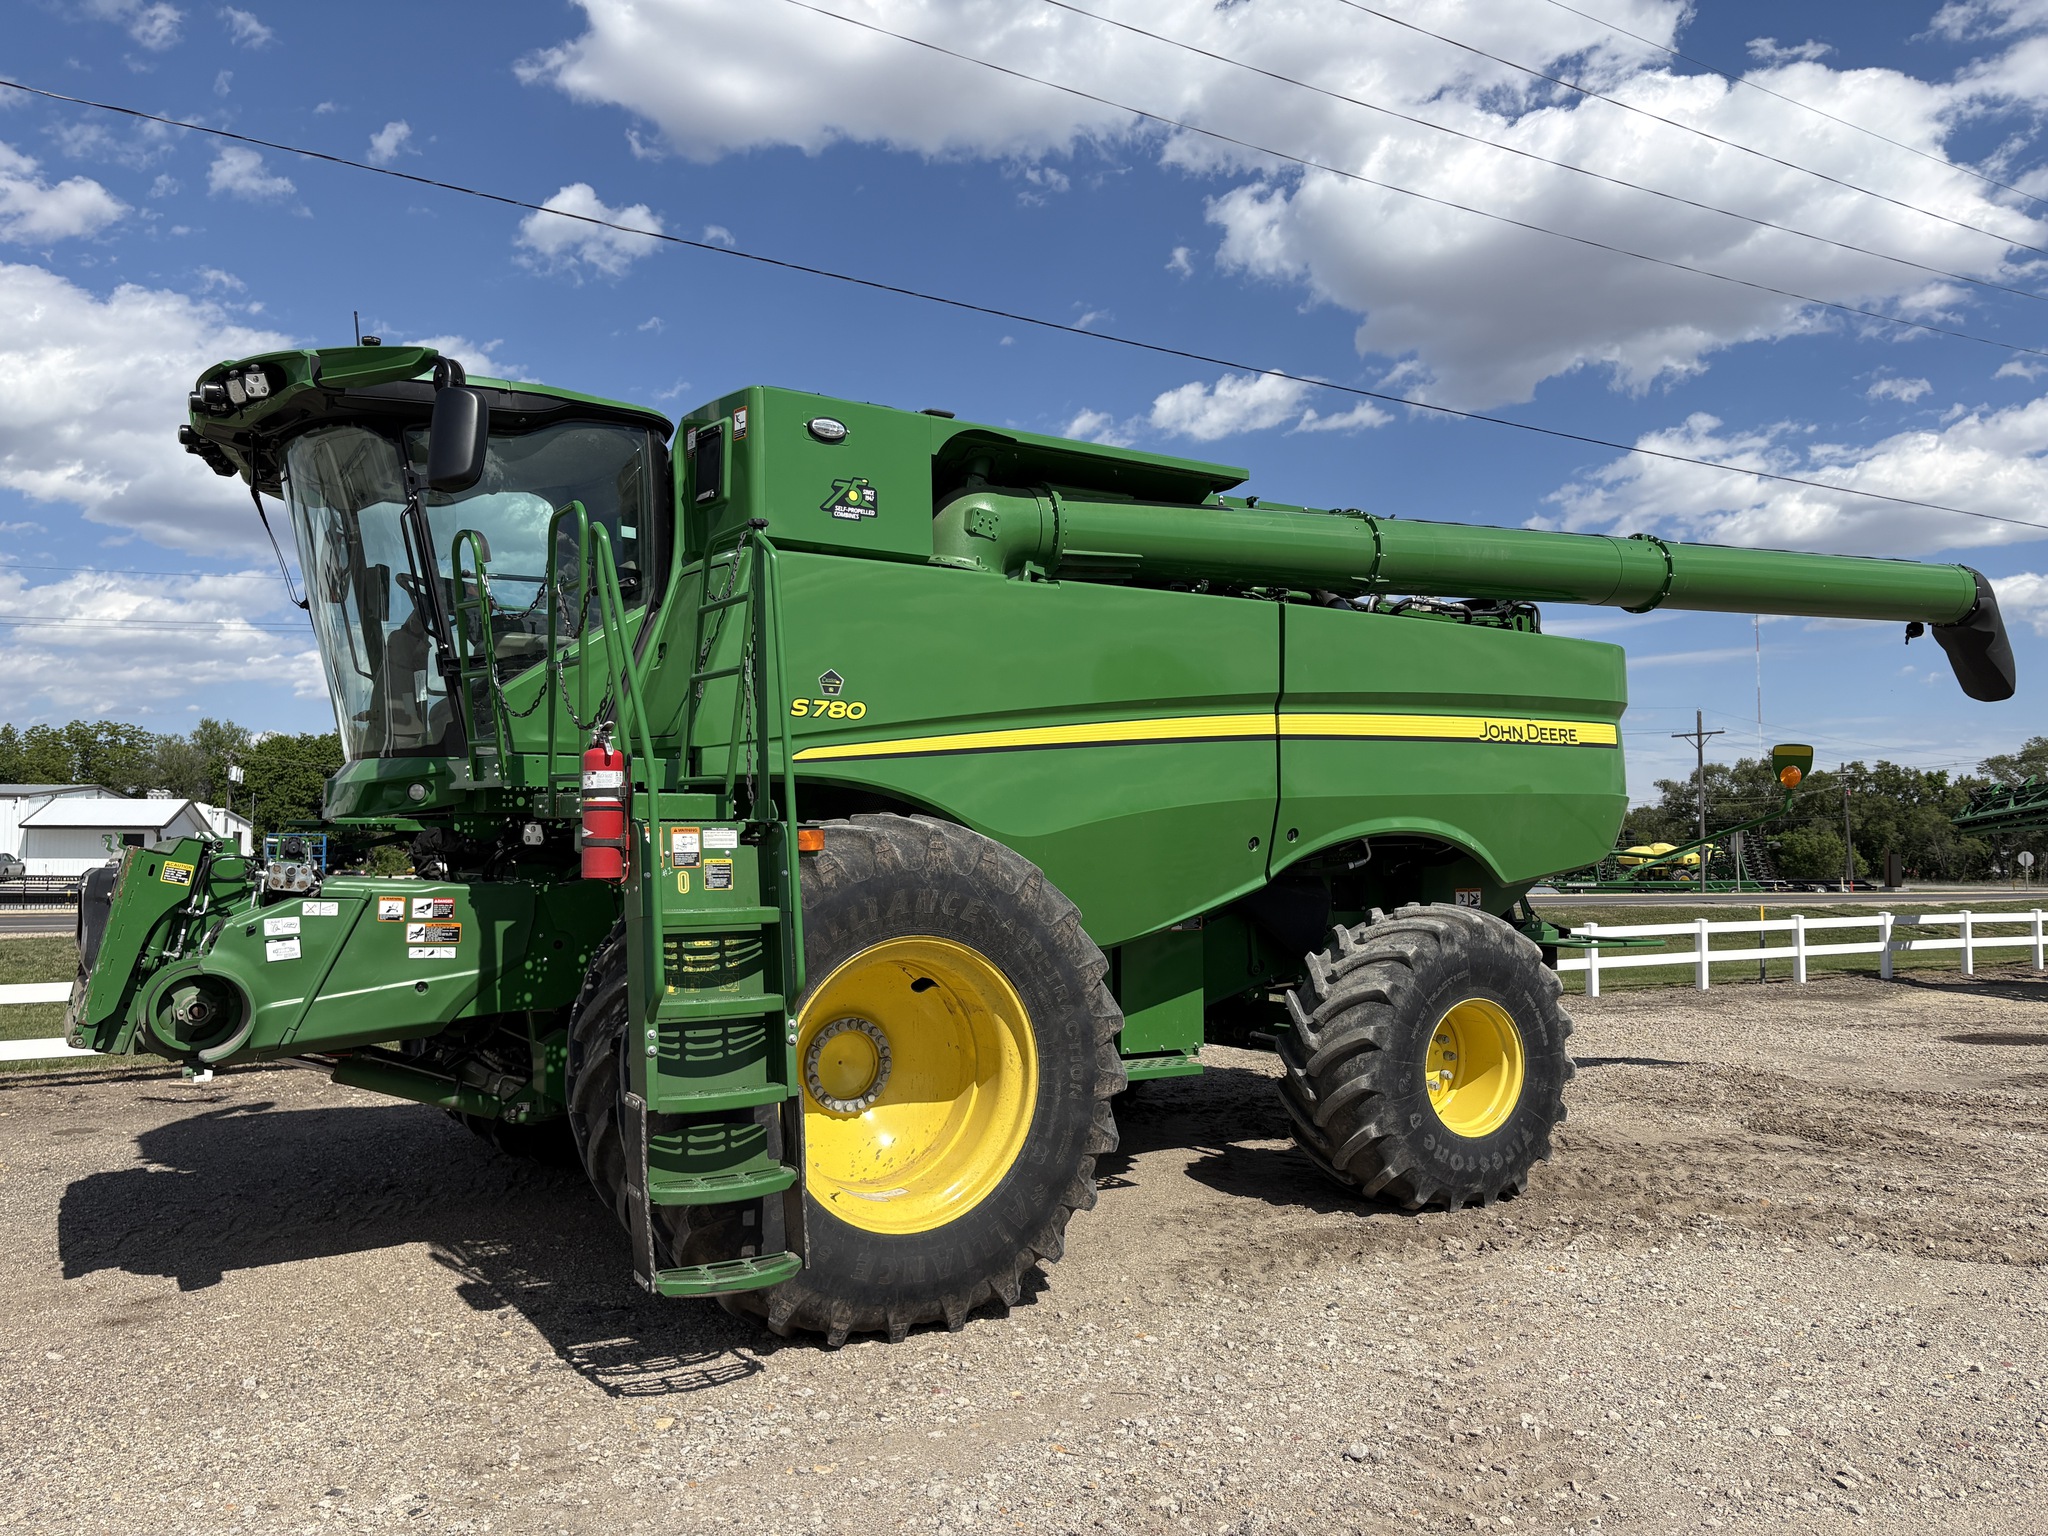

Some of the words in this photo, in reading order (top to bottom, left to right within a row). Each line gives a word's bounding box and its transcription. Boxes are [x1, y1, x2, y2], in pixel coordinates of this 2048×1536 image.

[823, 479, 867, 509] 75
[834, 511, 860, 519] COMBINES
[835, 505, 876, 516] SELF-PROPELLED
[790, 698, 867, 720] S780
[1480, 721, 1524, 740] JOHN
[1527, 723, 1578, 742] DEERE
[170, 862, 193, 870] CAUTION
[806, 888, 985, 968] ALLIANCE
